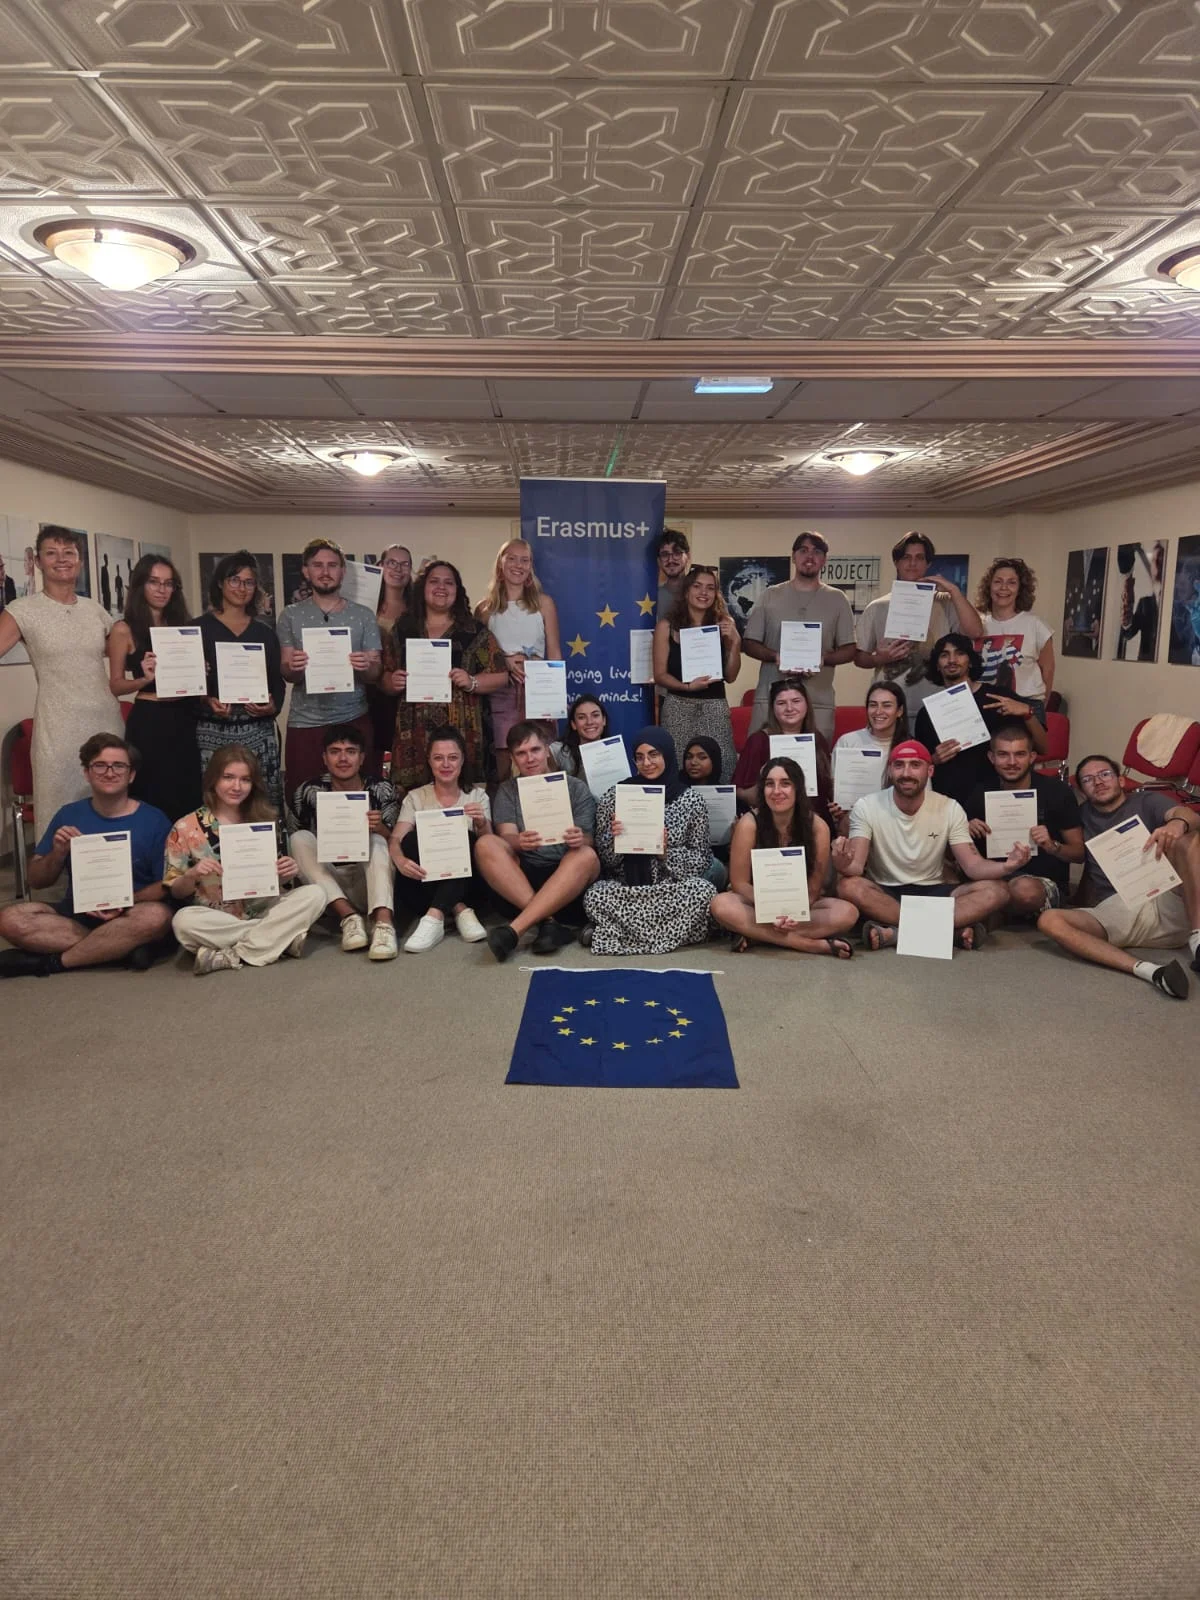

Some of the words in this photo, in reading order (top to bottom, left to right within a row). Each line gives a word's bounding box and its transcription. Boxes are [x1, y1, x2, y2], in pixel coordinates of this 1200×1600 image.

[537, 516, 650, 538] Erasmus+
[820, 564, 871, 580] PROJECT
[567, 669, 602, 684] nging
[609, 665, 632, 679] liv
[598, 687, 643, 702] minds!
